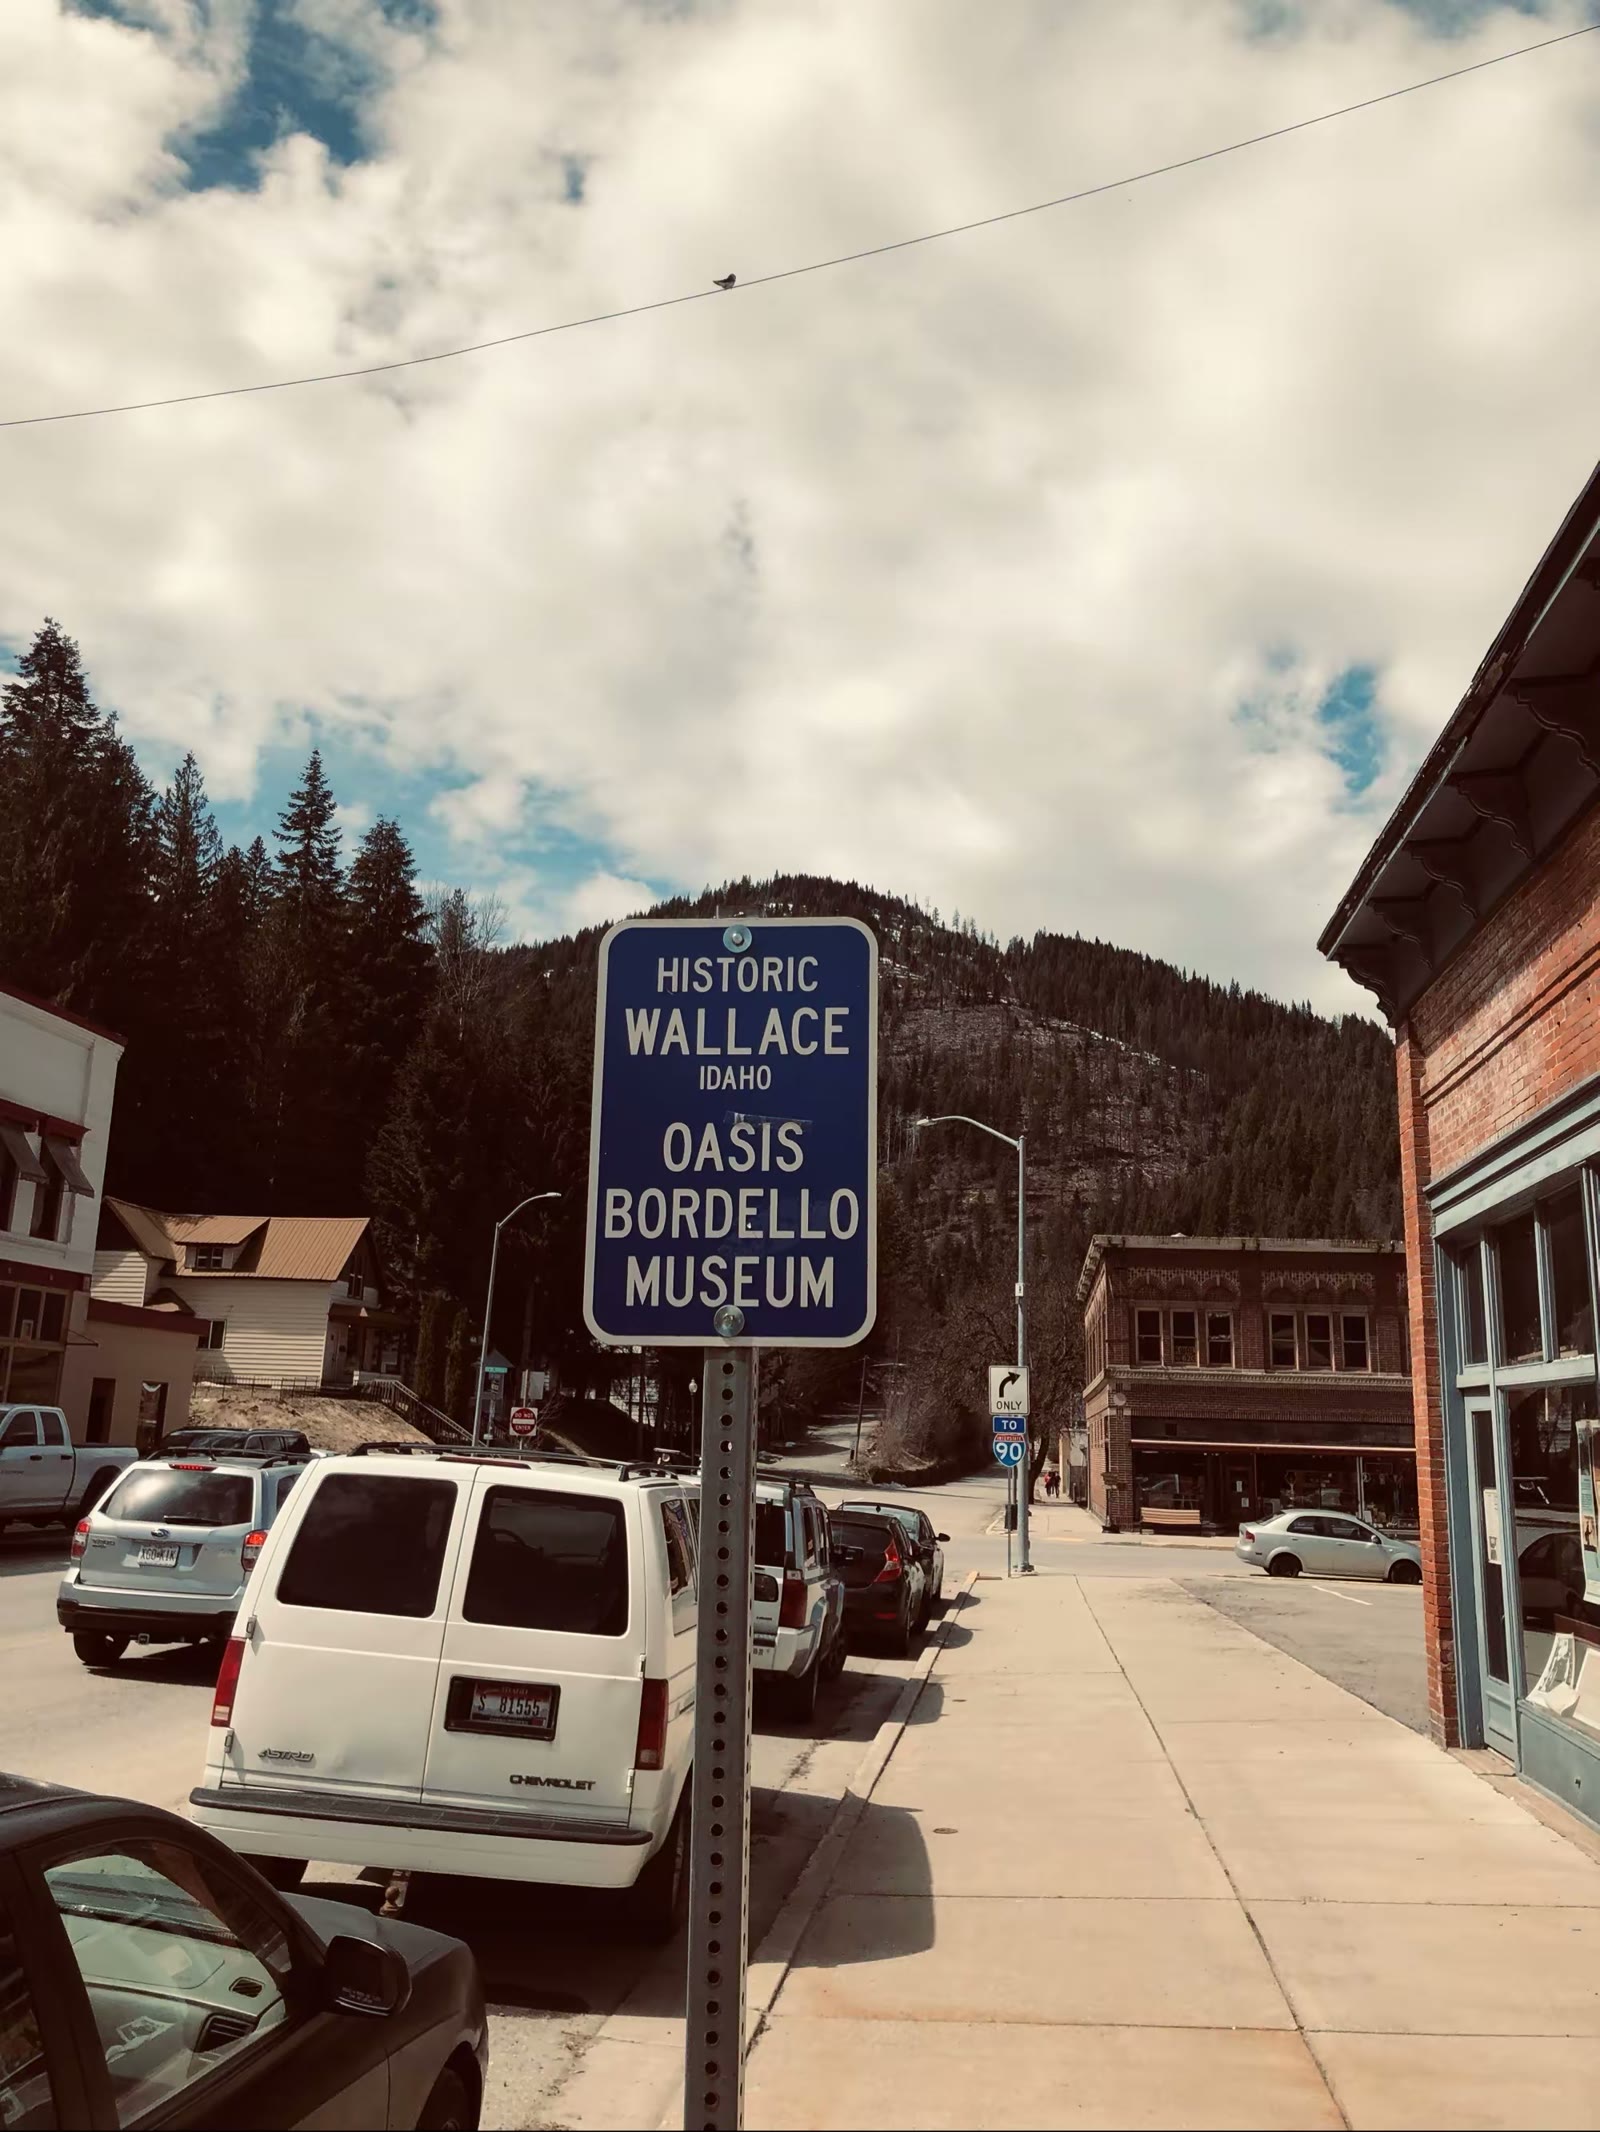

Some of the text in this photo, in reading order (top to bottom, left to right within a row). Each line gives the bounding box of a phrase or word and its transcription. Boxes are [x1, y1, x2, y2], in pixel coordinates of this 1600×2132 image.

[657, 956, 819, 993] HISTORIC
[625, 1007, 850, 1056] WALLACE
[699, 1065, 771, 1090] IDAHO
[663, 1121, 804, 1172] OASIS
[604, 1188, 859, 1240] BORDELLO
[625, 1255, 834, 1308] MUSEUM
[996, 1401, 1022, 1410] ONLY
[1002, 1420, 1017, 1430] TO
[996, 1442, 1022, 1460] 90
[258, 1748, 314, 1762] ASTRO
[509, 1774, 596, 1790] CHEVROLET
